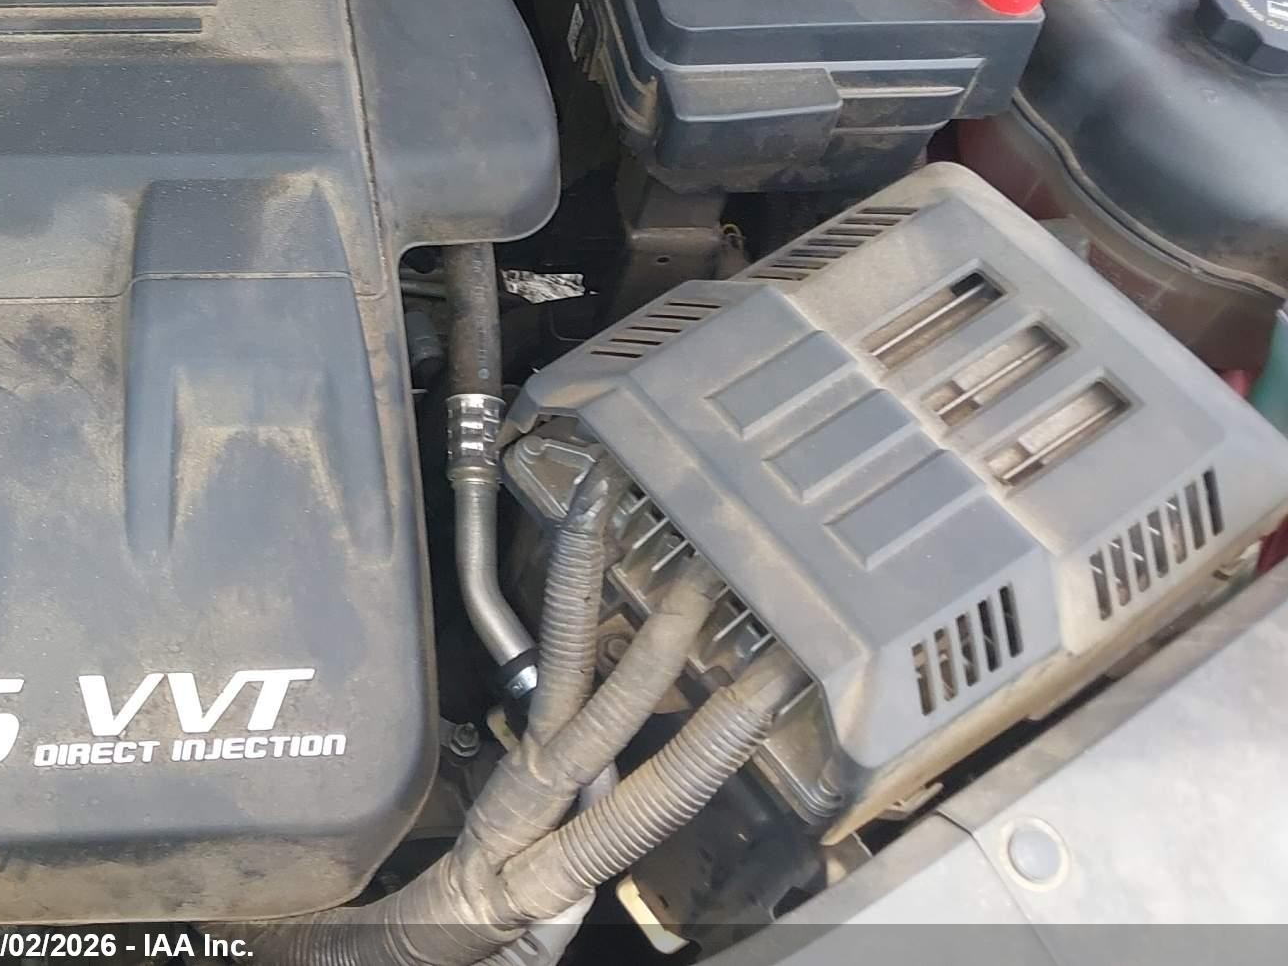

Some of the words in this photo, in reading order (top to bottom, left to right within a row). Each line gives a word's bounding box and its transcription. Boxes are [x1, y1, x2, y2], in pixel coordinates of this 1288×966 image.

[78, 668, 315, 736] VVT
[34, 740, 160, 767] DIRECT
[171, 734, 346, 762] INJECTION
